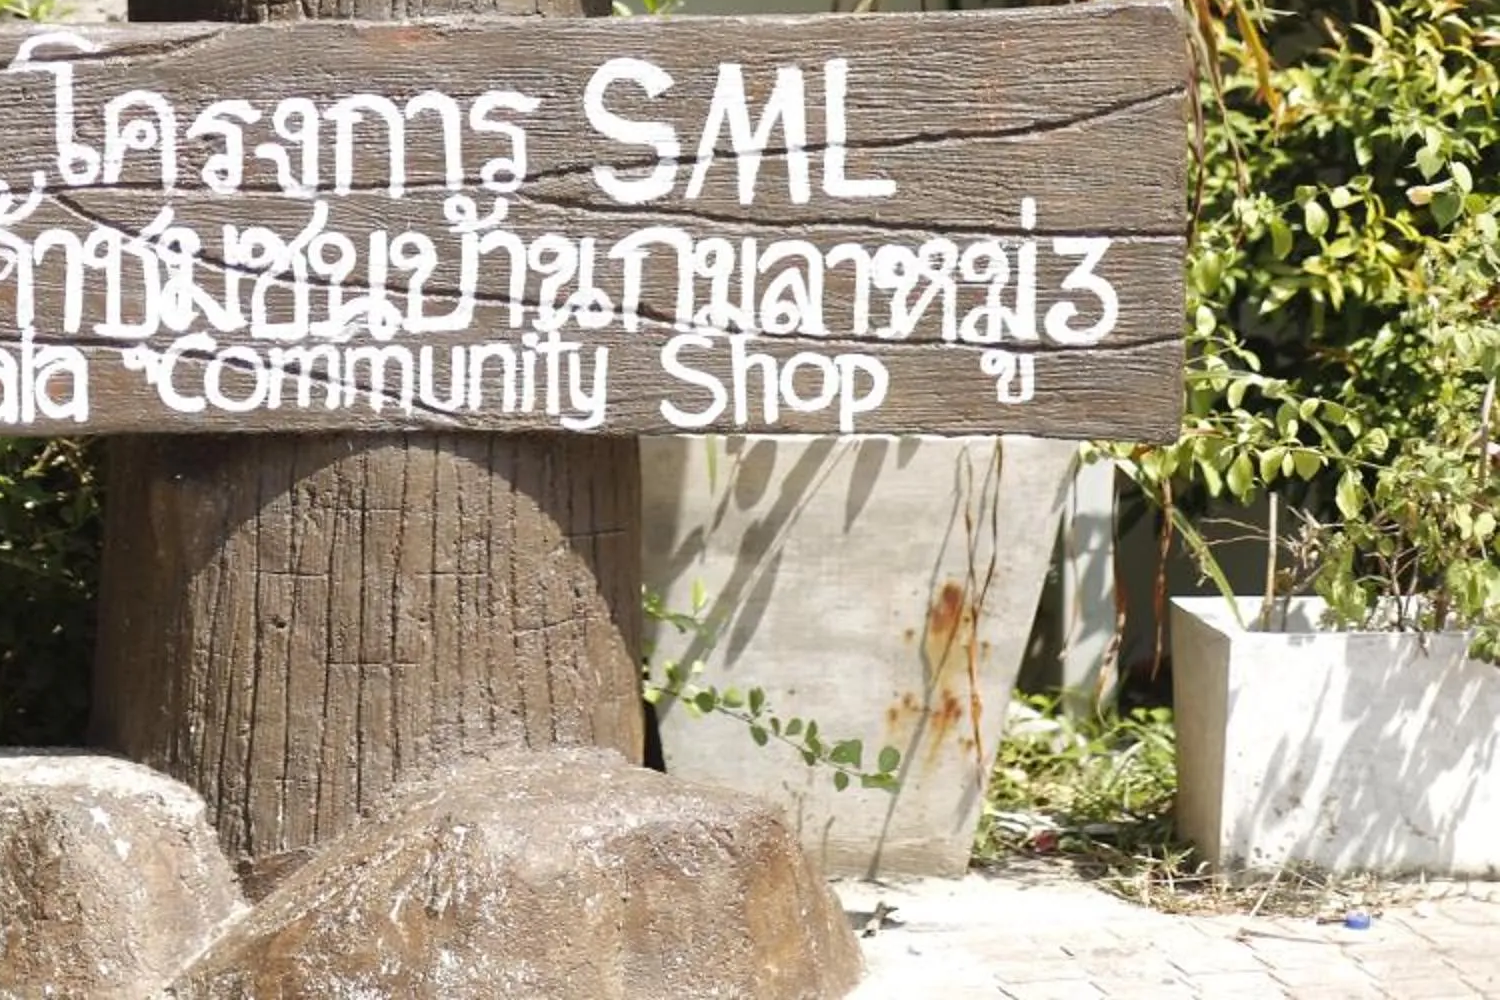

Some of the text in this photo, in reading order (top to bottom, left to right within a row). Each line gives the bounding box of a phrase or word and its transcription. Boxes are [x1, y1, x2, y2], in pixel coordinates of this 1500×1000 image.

[8, 30, 897, 205] โครงการ SML
[156, 330, 609, 432] Community
[659, 332, 890, 434] Shop
